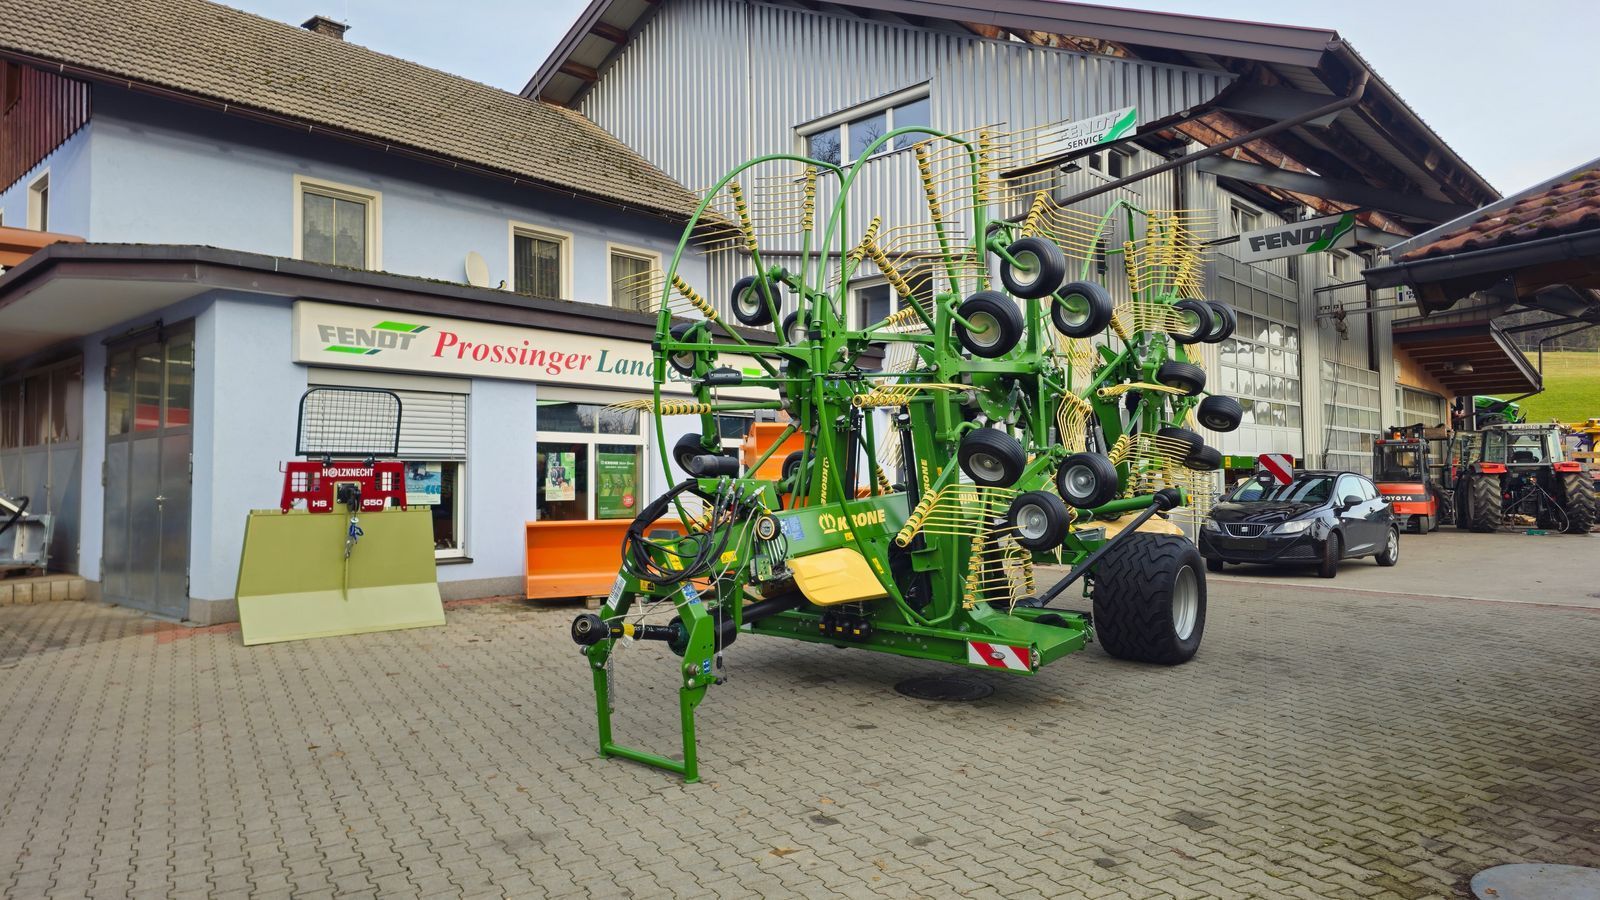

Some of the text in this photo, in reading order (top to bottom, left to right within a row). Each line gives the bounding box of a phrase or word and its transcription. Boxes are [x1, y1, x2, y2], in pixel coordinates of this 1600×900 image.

[1067, 133, 1104, 150] SERVICE
[1248, 222, 1341, 252] FENDT
[317, 324, 417, 350] FENDT
[432, 331, 592, 376] Prossinger
[322, 468, 374, 478] HOLZKNECHT
[820, 467, 829, 506] KRONE
[920, 458, 931, 494] RONE
